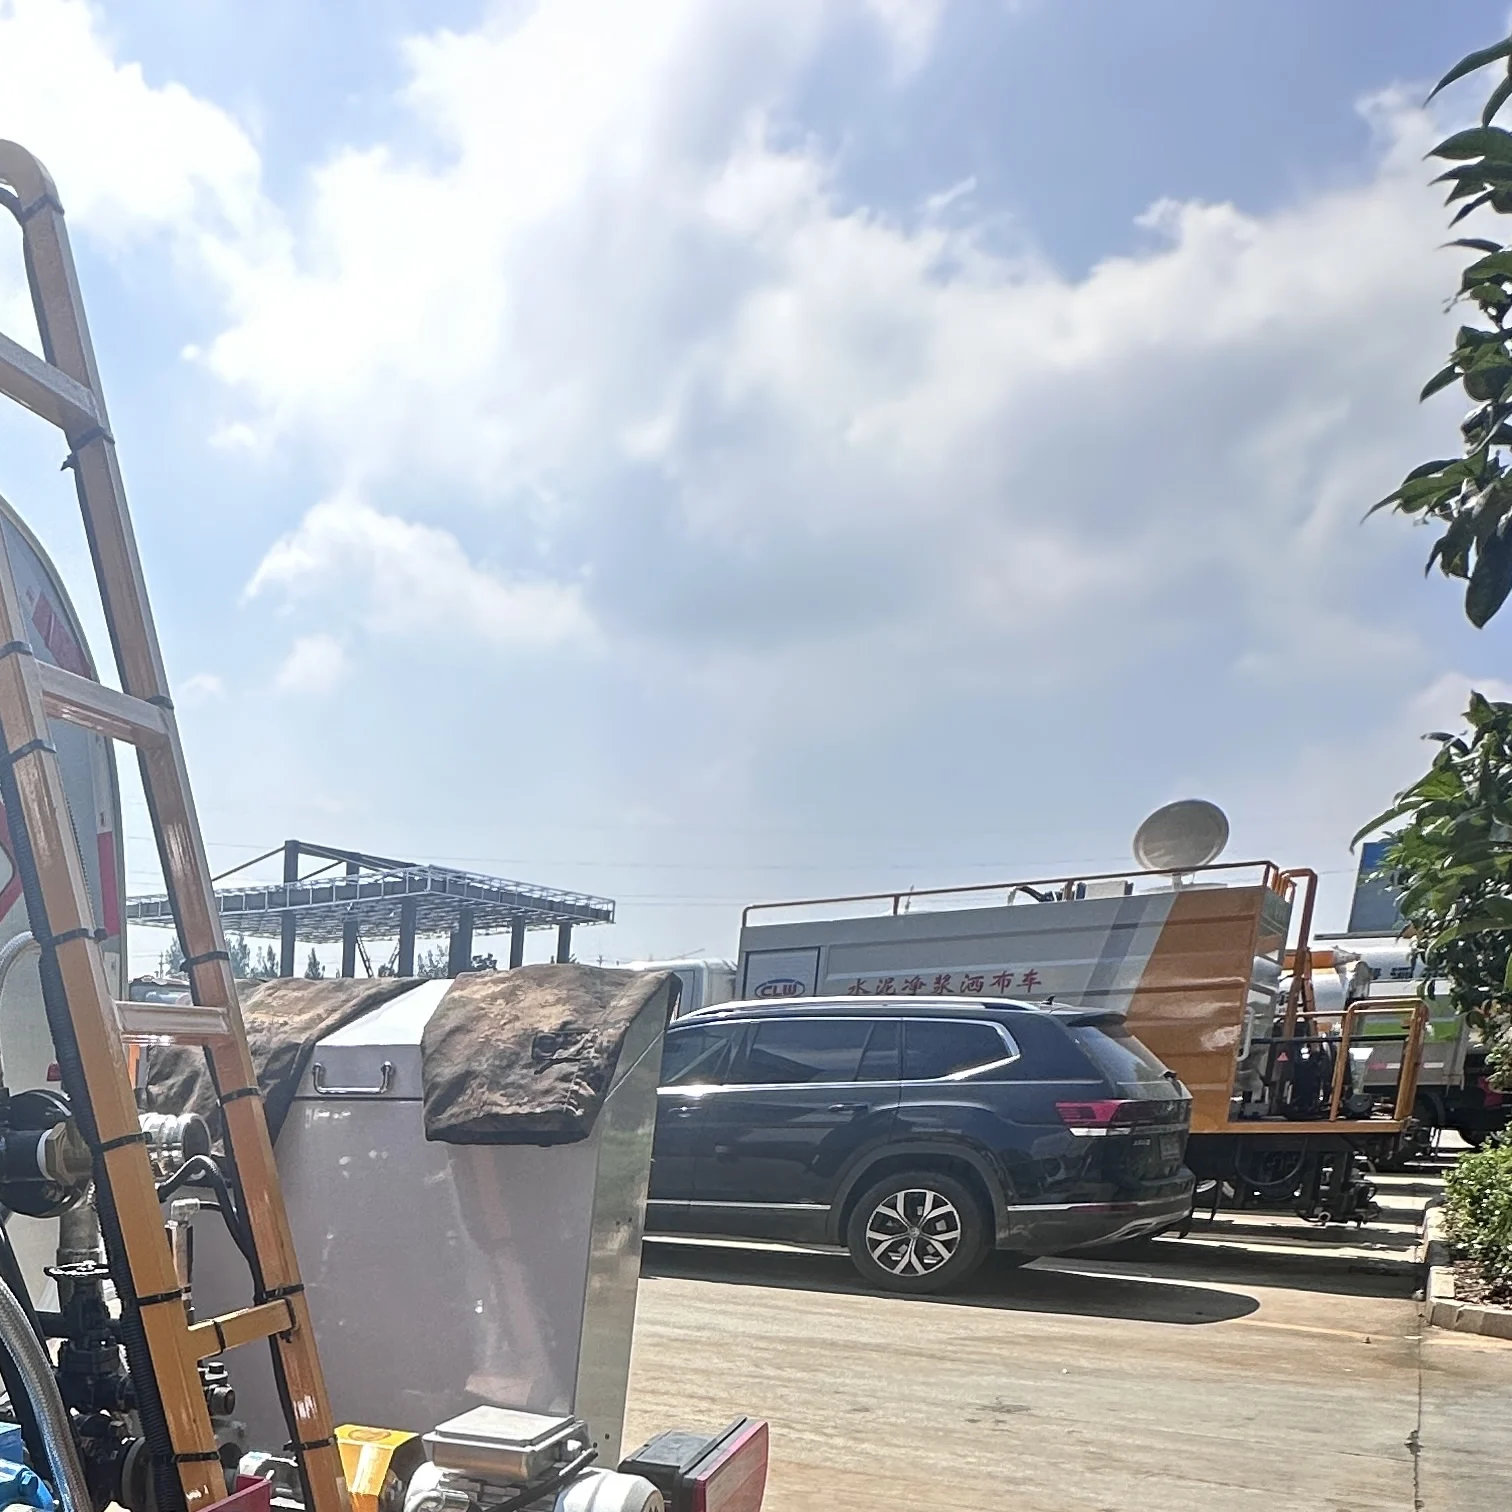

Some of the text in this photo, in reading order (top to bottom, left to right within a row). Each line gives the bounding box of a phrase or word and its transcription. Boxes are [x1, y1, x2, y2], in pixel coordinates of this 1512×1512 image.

[760, 984, 798, 997] CLW
[847, 968, 1042, 996] 水泥净浆洒布车
